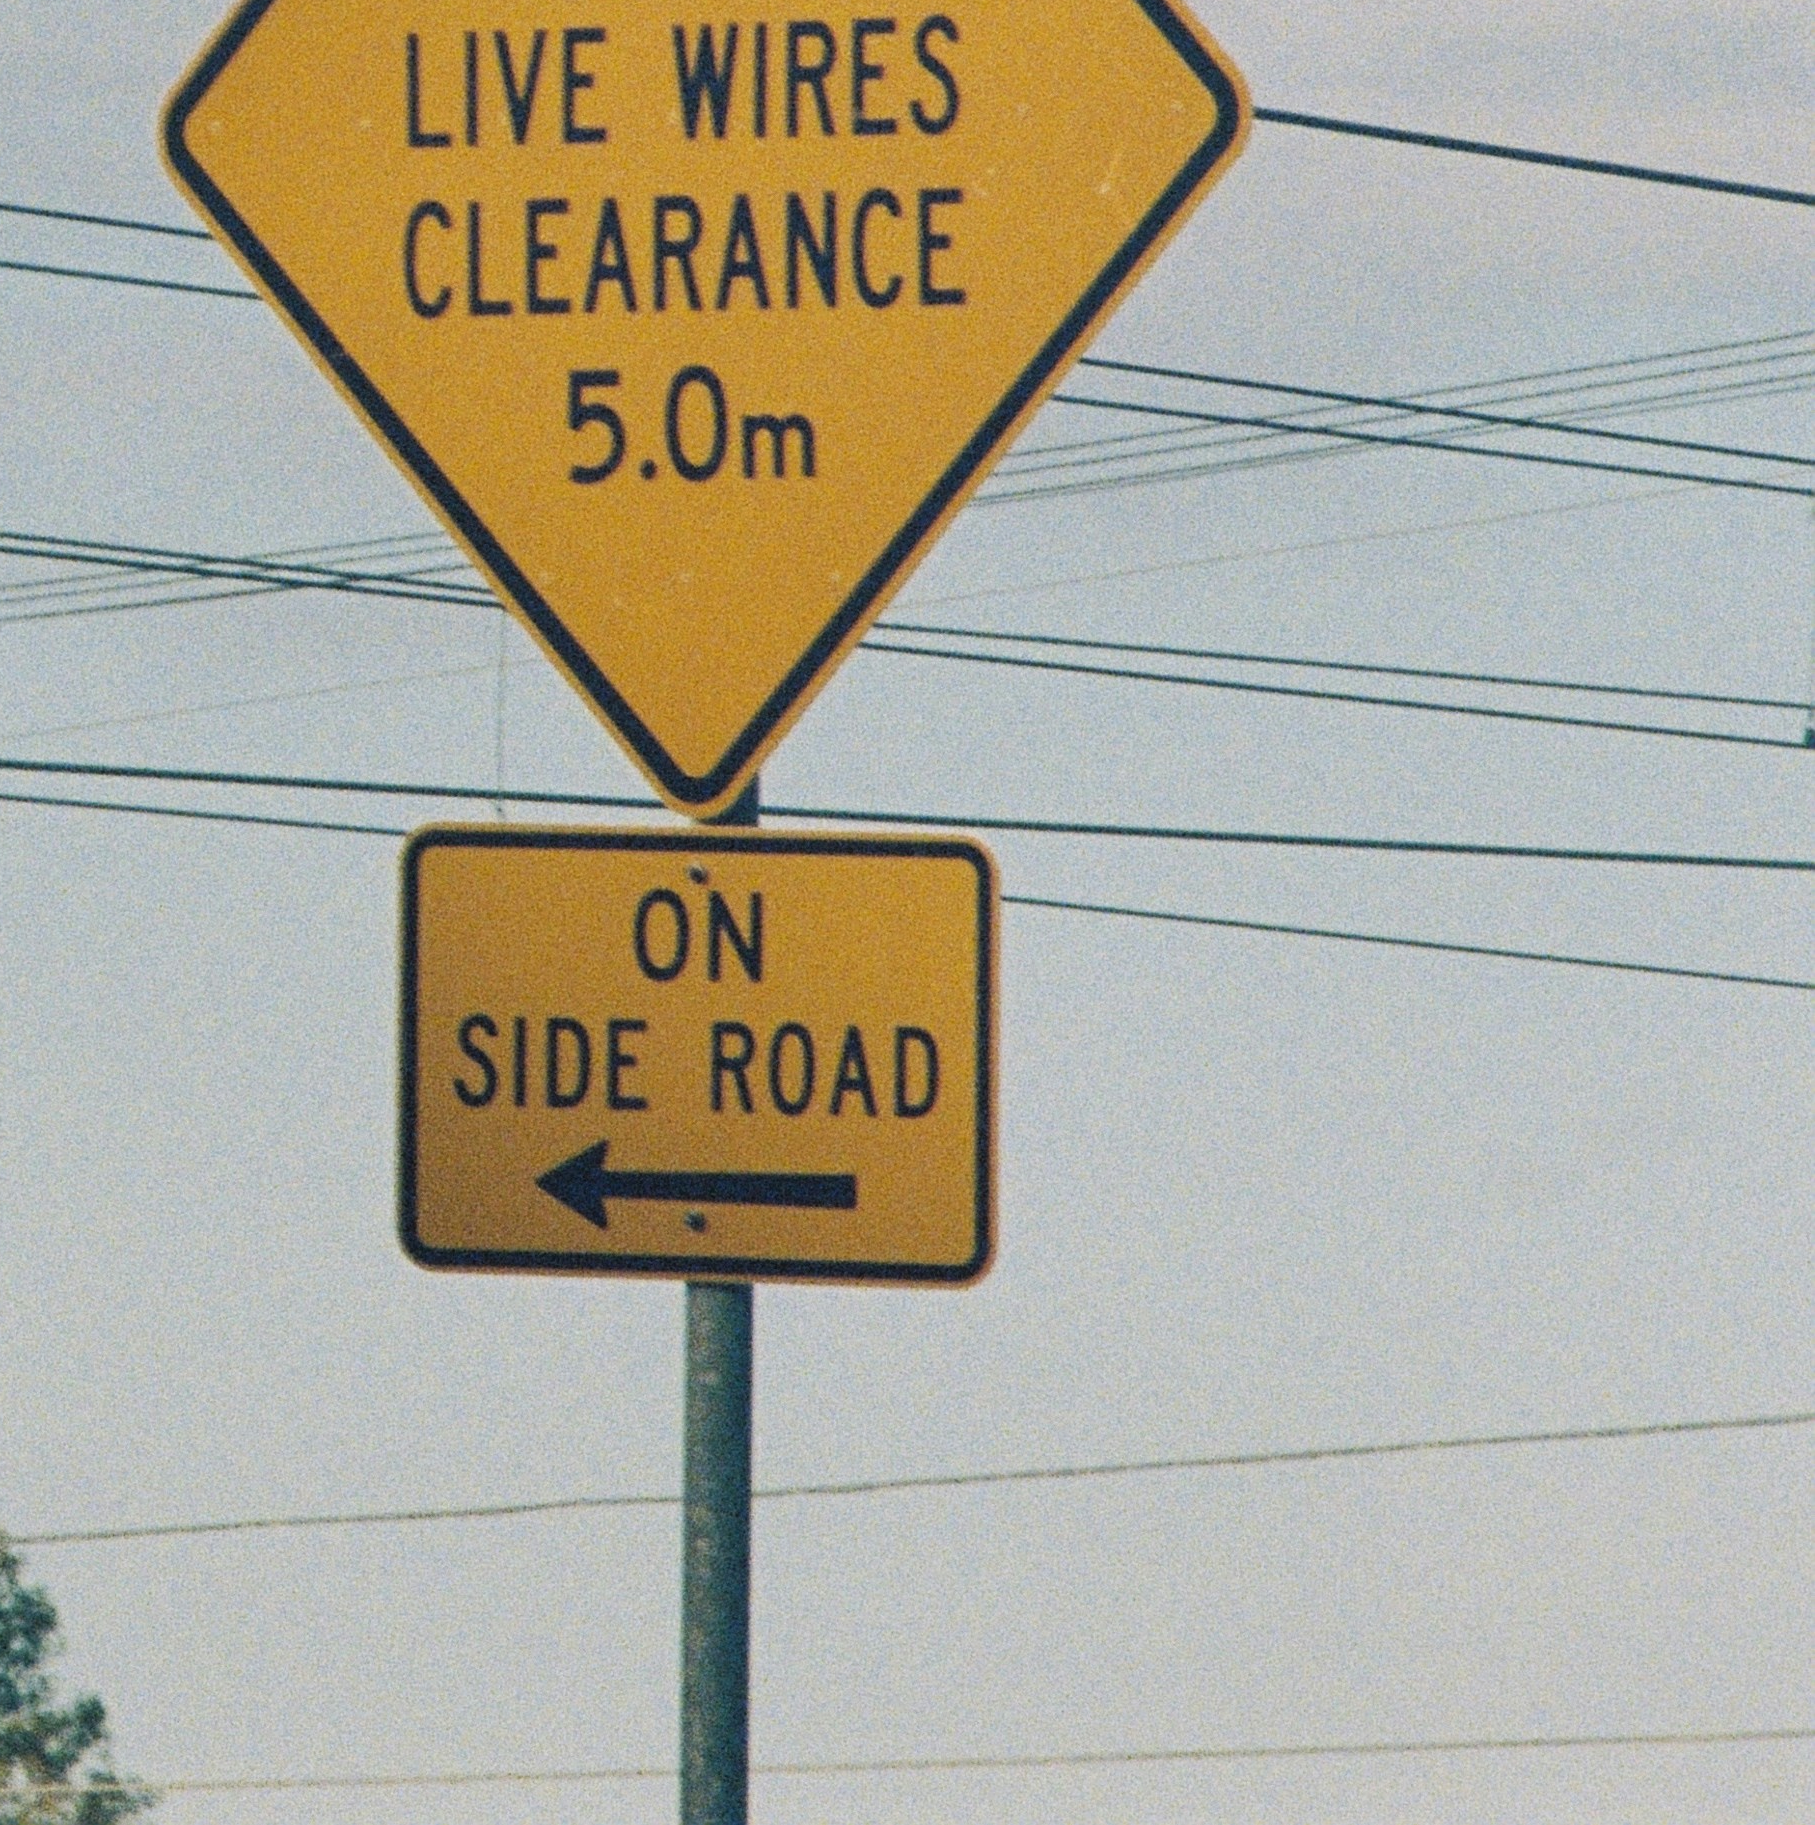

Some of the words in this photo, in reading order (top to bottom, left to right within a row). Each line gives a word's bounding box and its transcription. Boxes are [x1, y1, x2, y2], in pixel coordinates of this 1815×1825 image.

[406, 27, 607, 148] LIVE
[673, 14, 959, 139] WIRES
[403, 187, 966, 319] CLEARANCE
[567, 365, 815, 485] 5.0m
[633, 888, 763, 983] ON
[453, 1013, 648, 1111] SIDE
[710, 1021, 939, 1119] ROAD
